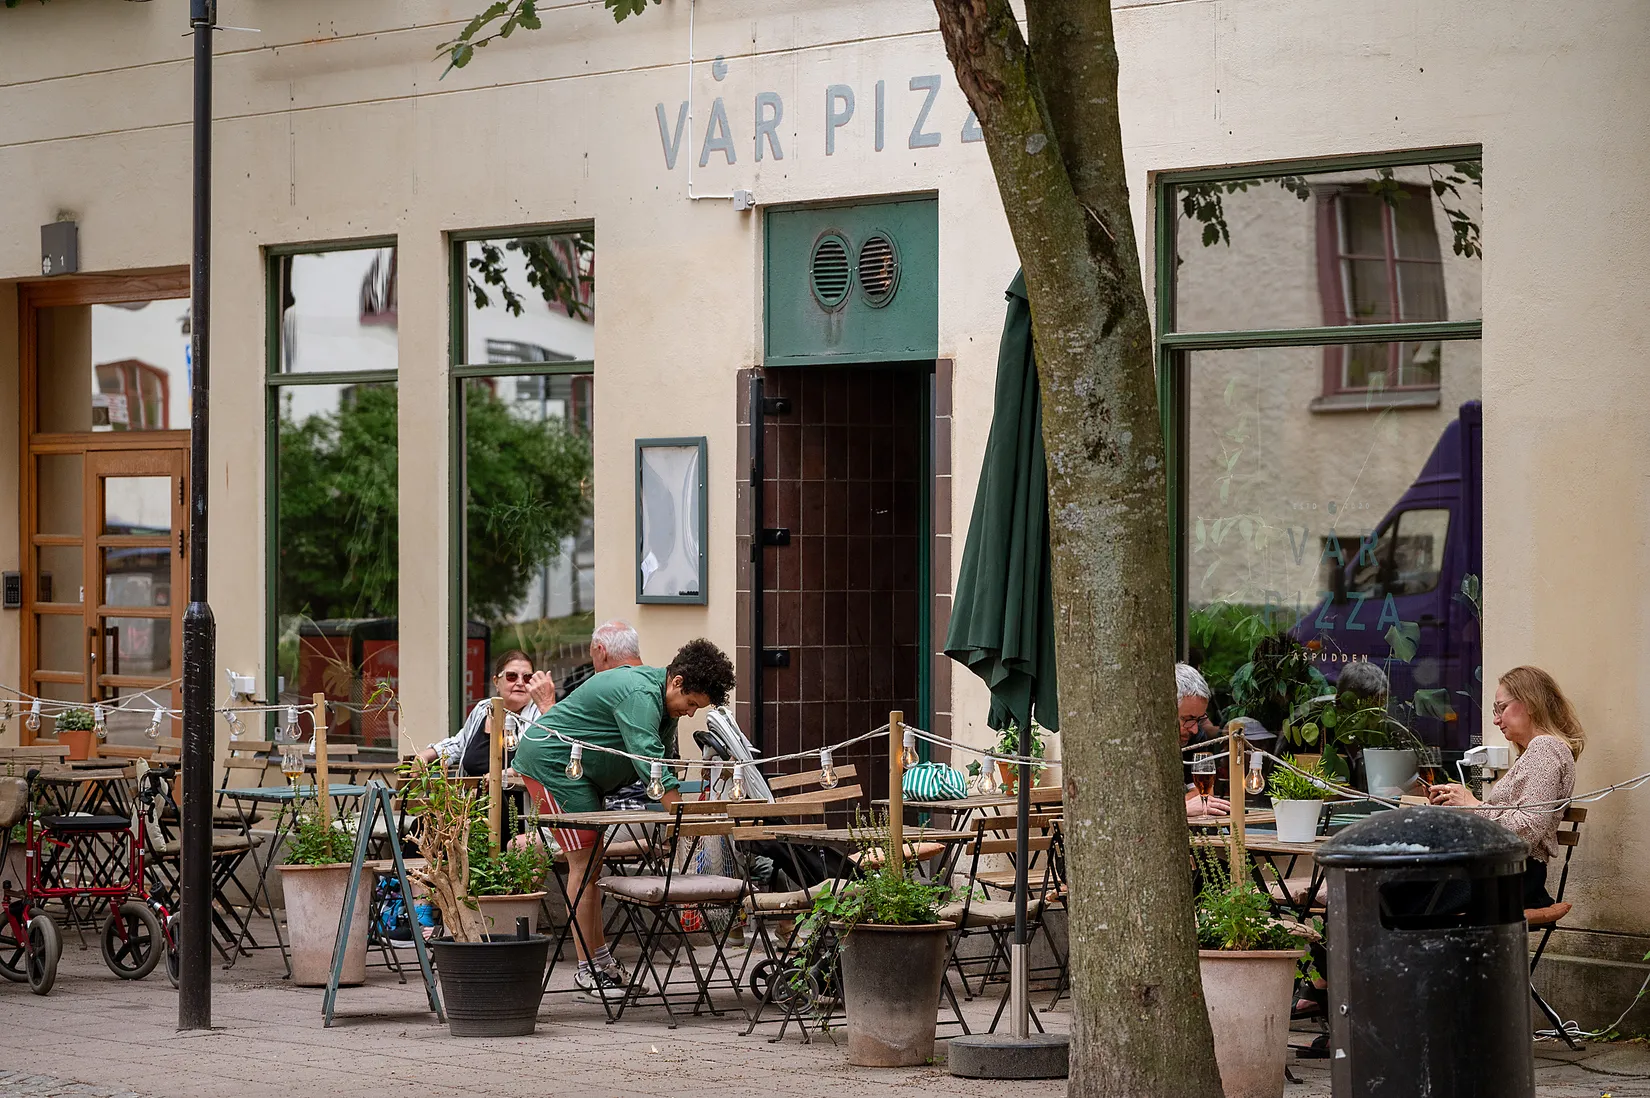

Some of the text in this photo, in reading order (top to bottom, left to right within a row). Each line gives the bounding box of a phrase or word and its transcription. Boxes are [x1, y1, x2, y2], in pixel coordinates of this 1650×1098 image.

[655, 55, 783, 170] VÅR
[1265, 591, 1401, 631] PIZZA
[1292, 652, 1369, 663] ASPUDDEN
